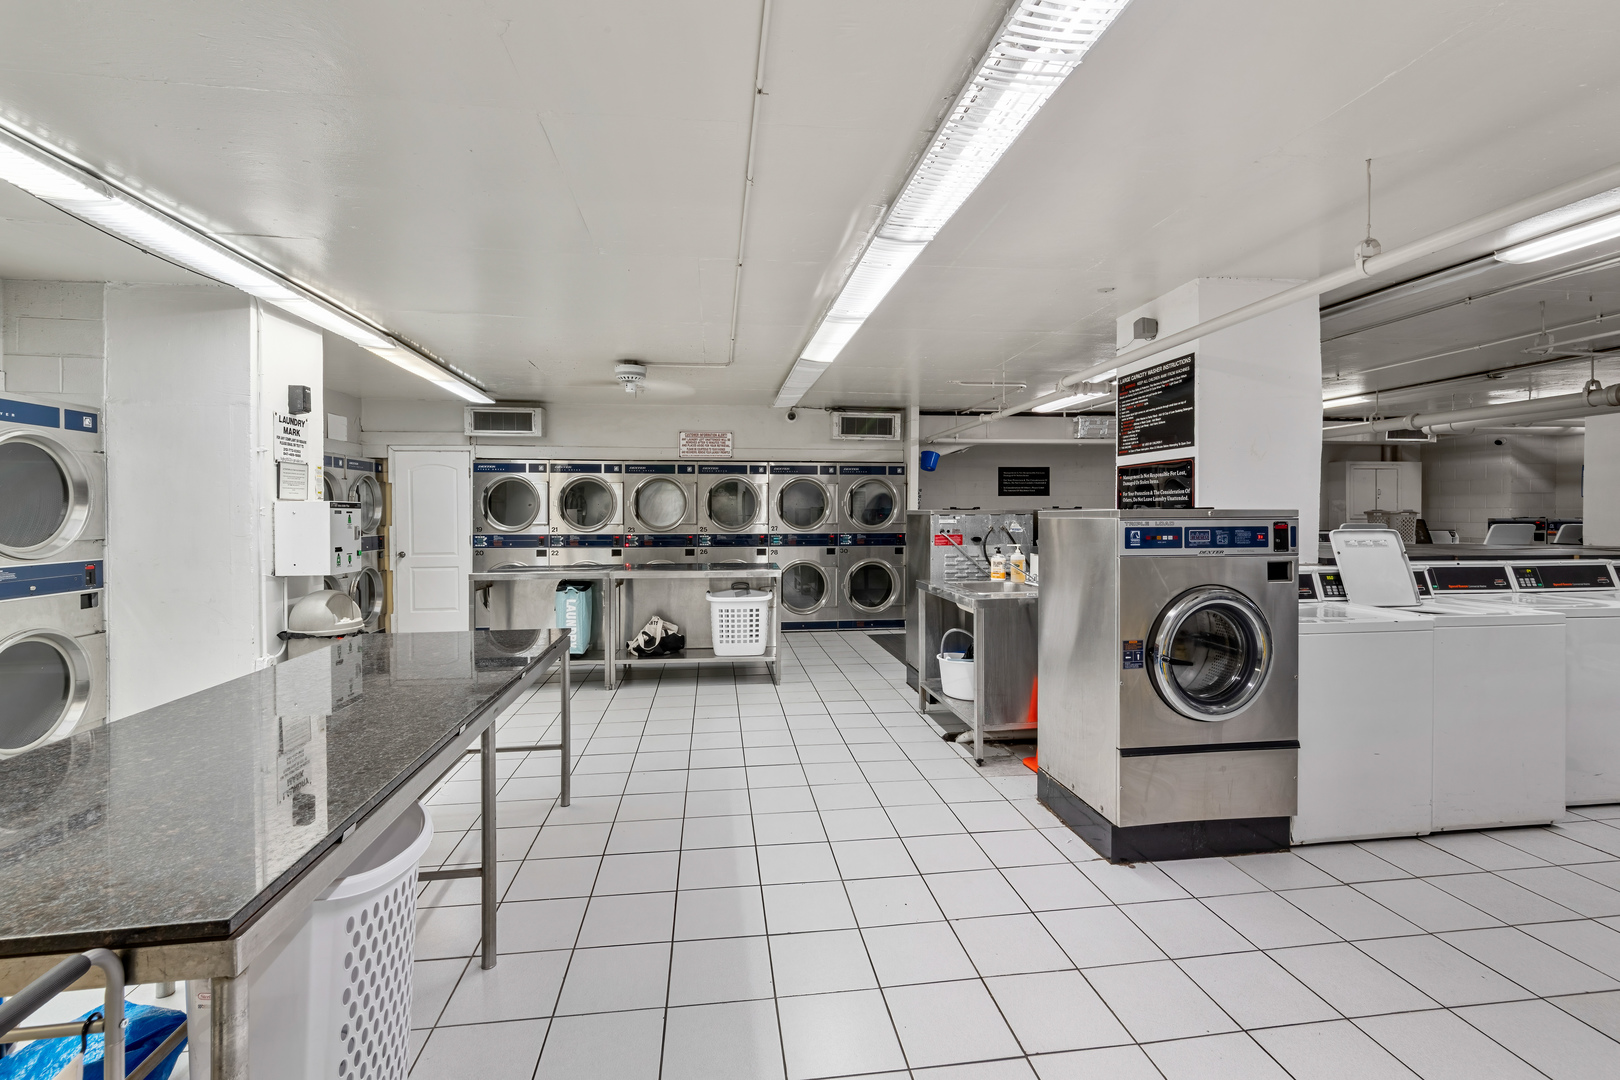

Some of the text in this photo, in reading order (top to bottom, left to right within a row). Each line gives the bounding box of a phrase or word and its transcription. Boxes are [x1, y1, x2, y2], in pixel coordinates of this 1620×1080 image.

[1163, 357, 1191, 370] INSTRUCTIONS
[279, 415, 305, 427] LAUNDRY
[283, 427, 300, 437] MARK
